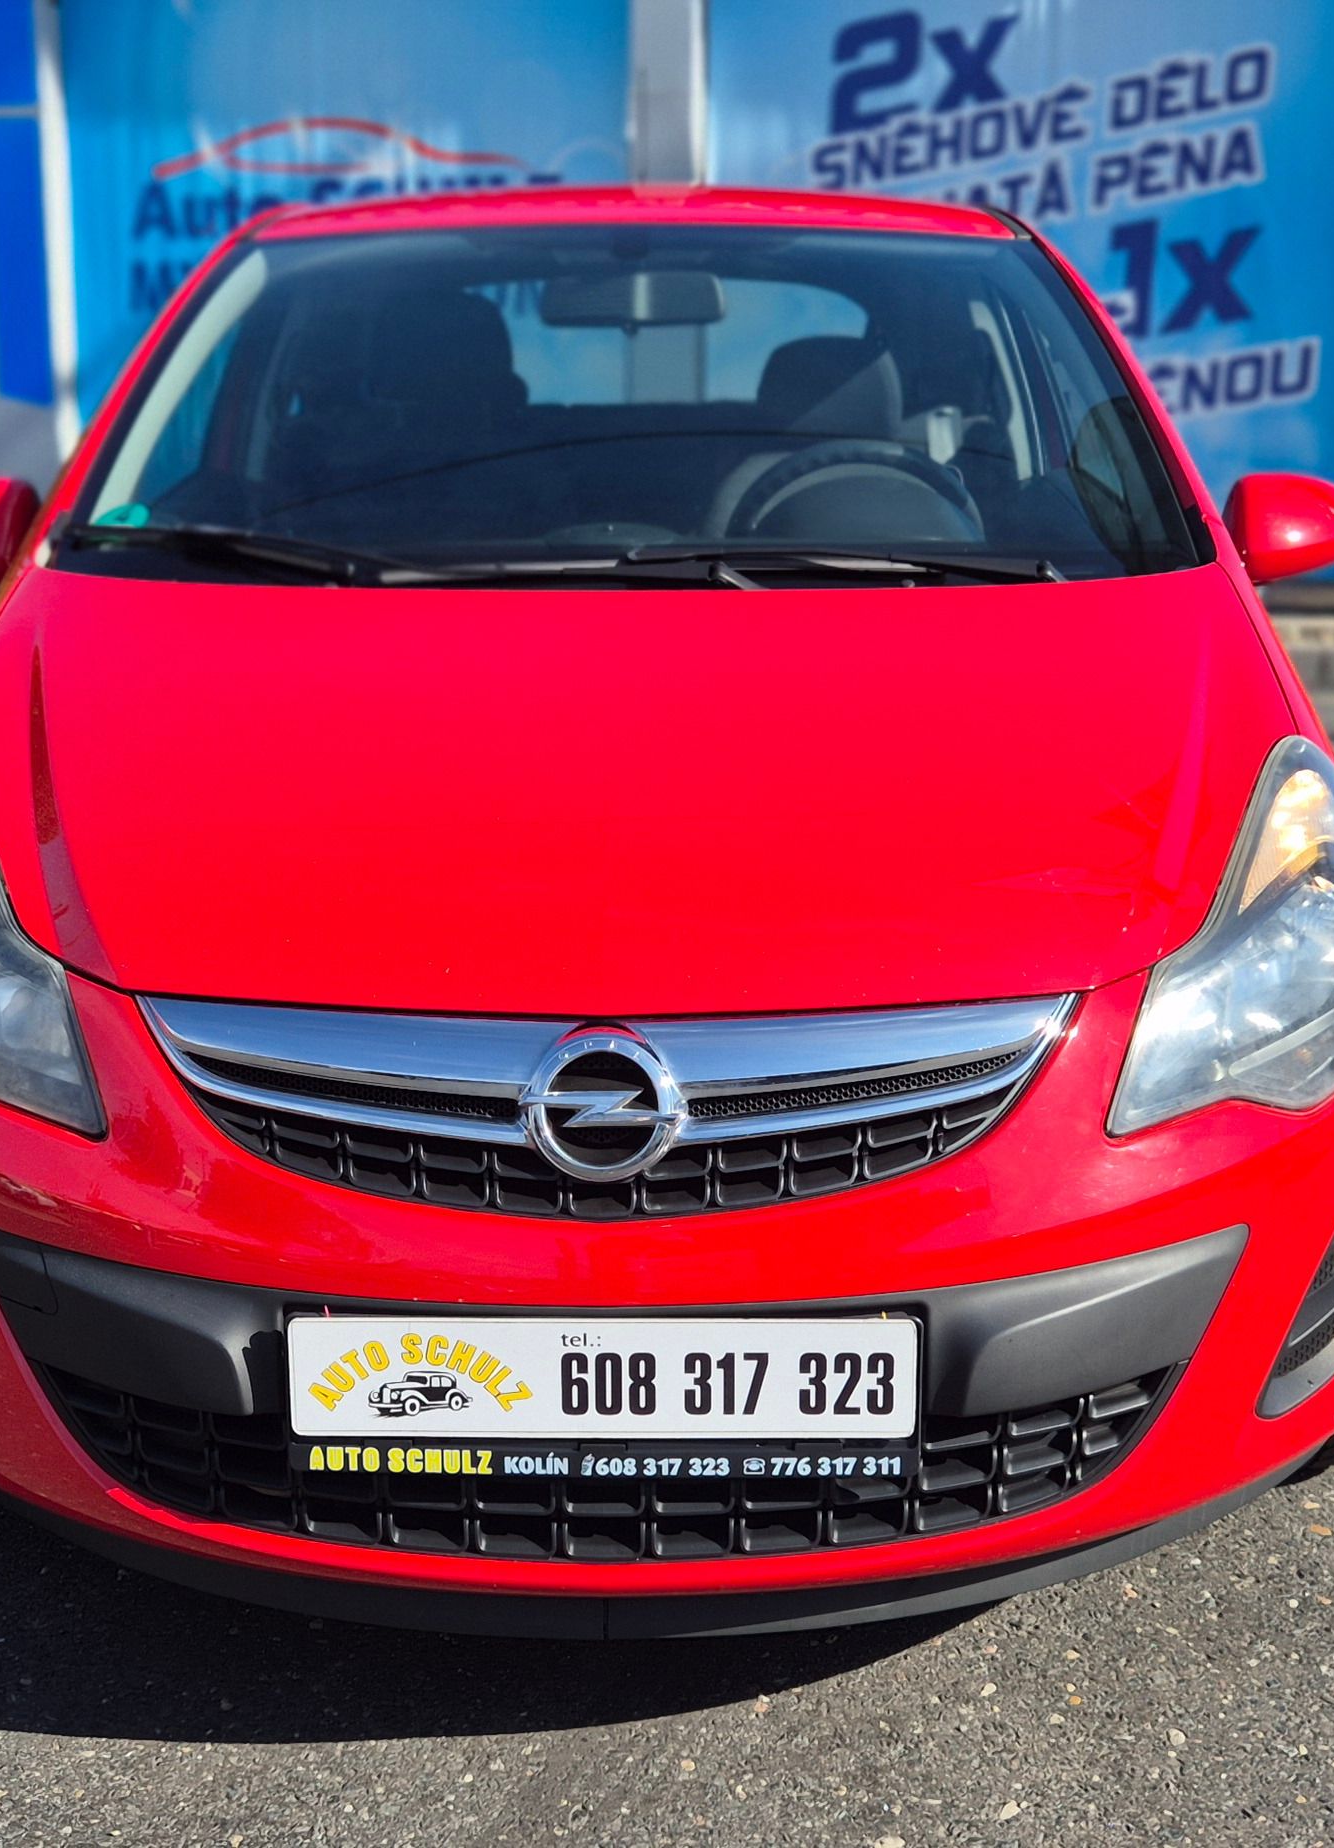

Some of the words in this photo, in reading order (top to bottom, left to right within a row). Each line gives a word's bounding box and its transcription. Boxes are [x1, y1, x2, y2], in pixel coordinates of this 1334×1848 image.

[830, 9, 1018, 136] 2x
[1109, 218, 1263, 340] 1x
[308, 1340, 390, 1412] AUTO
[401, 1333, 533, 1412] SCHULZ
[561, 1333, 601, 1347] tel.:
[561, 1352, 656, 1415] 608
[684, 1352, 769, 1415] 317
[799, 1352, 895, 1415] 323
[309, 1446, 380, 1472] AUTO
[387, 1447, 493, 1475] SCHULZ
[503, 1452, 569, 1475] KOLÍN
[595, 1457, 637, 1476] 608
[643, 1457, 682, 1476] 317
[688, 1457, 730, 1476] 323
[770, 1457, 812, 1476] 776
[816, 1456, 858, 1476] 317
[862, 1456, 902, 1475] 311
